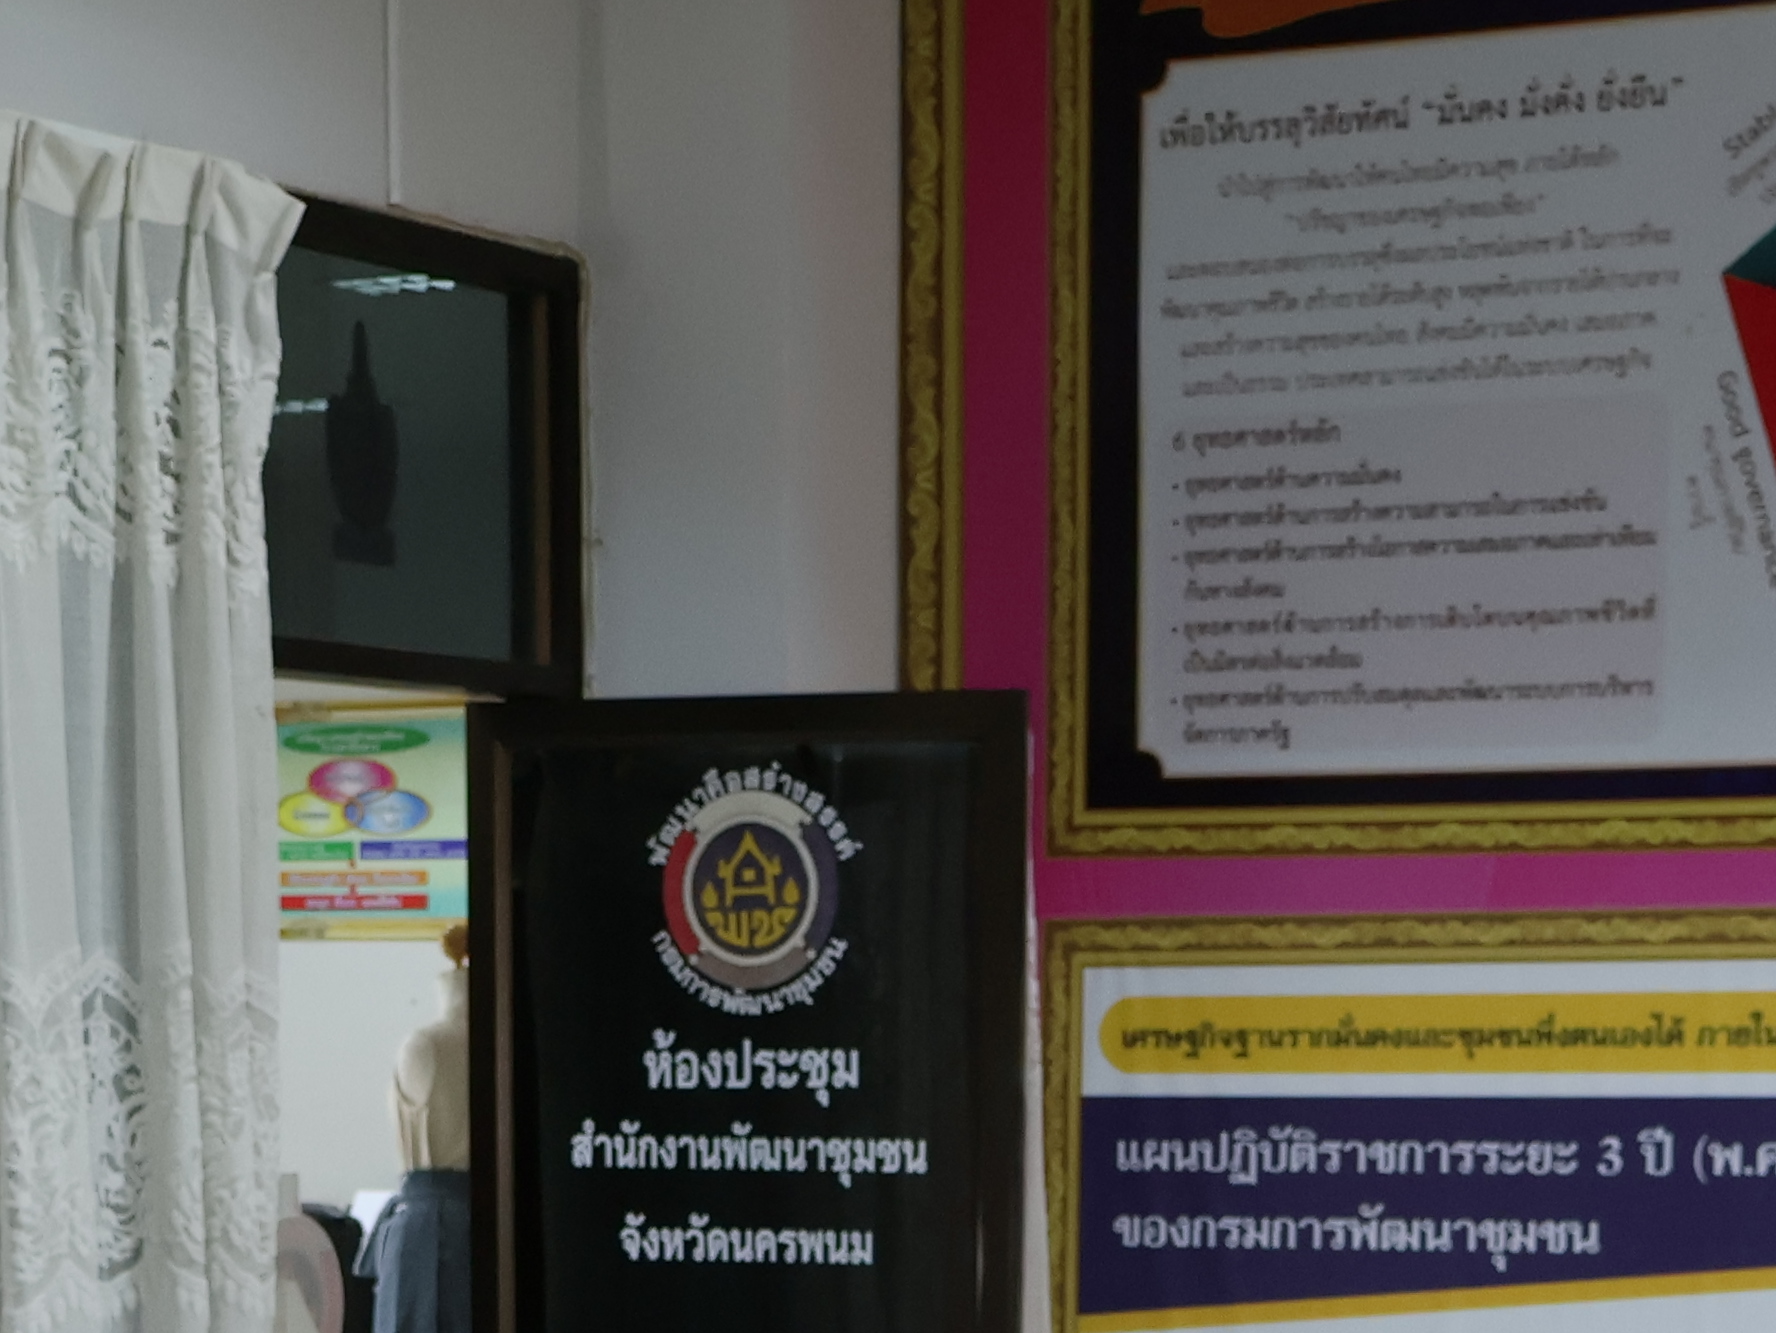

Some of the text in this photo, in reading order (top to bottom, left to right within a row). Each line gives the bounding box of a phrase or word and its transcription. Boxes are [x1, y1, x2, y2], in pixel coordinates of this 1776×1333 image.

[1715, 369, 1753, 441] Good
[642, 1026, 860, 1109] ห้องประชุม
[569, 1117, 928, 1190] สำนักงานพัฒนาชุมชน
[1115, 1123, 1579, 1187] แผนปฏิบัติราชการระยะ
[1596, 1135, 1624, 1177] 3
[1636, 1124, 1675, 1178] ปี
[619, 1211, 875, 1266] จังหวัดนครพนม
[1111, 1202, 1602, 1272] ของกรมการพัฒนาชุมชน
